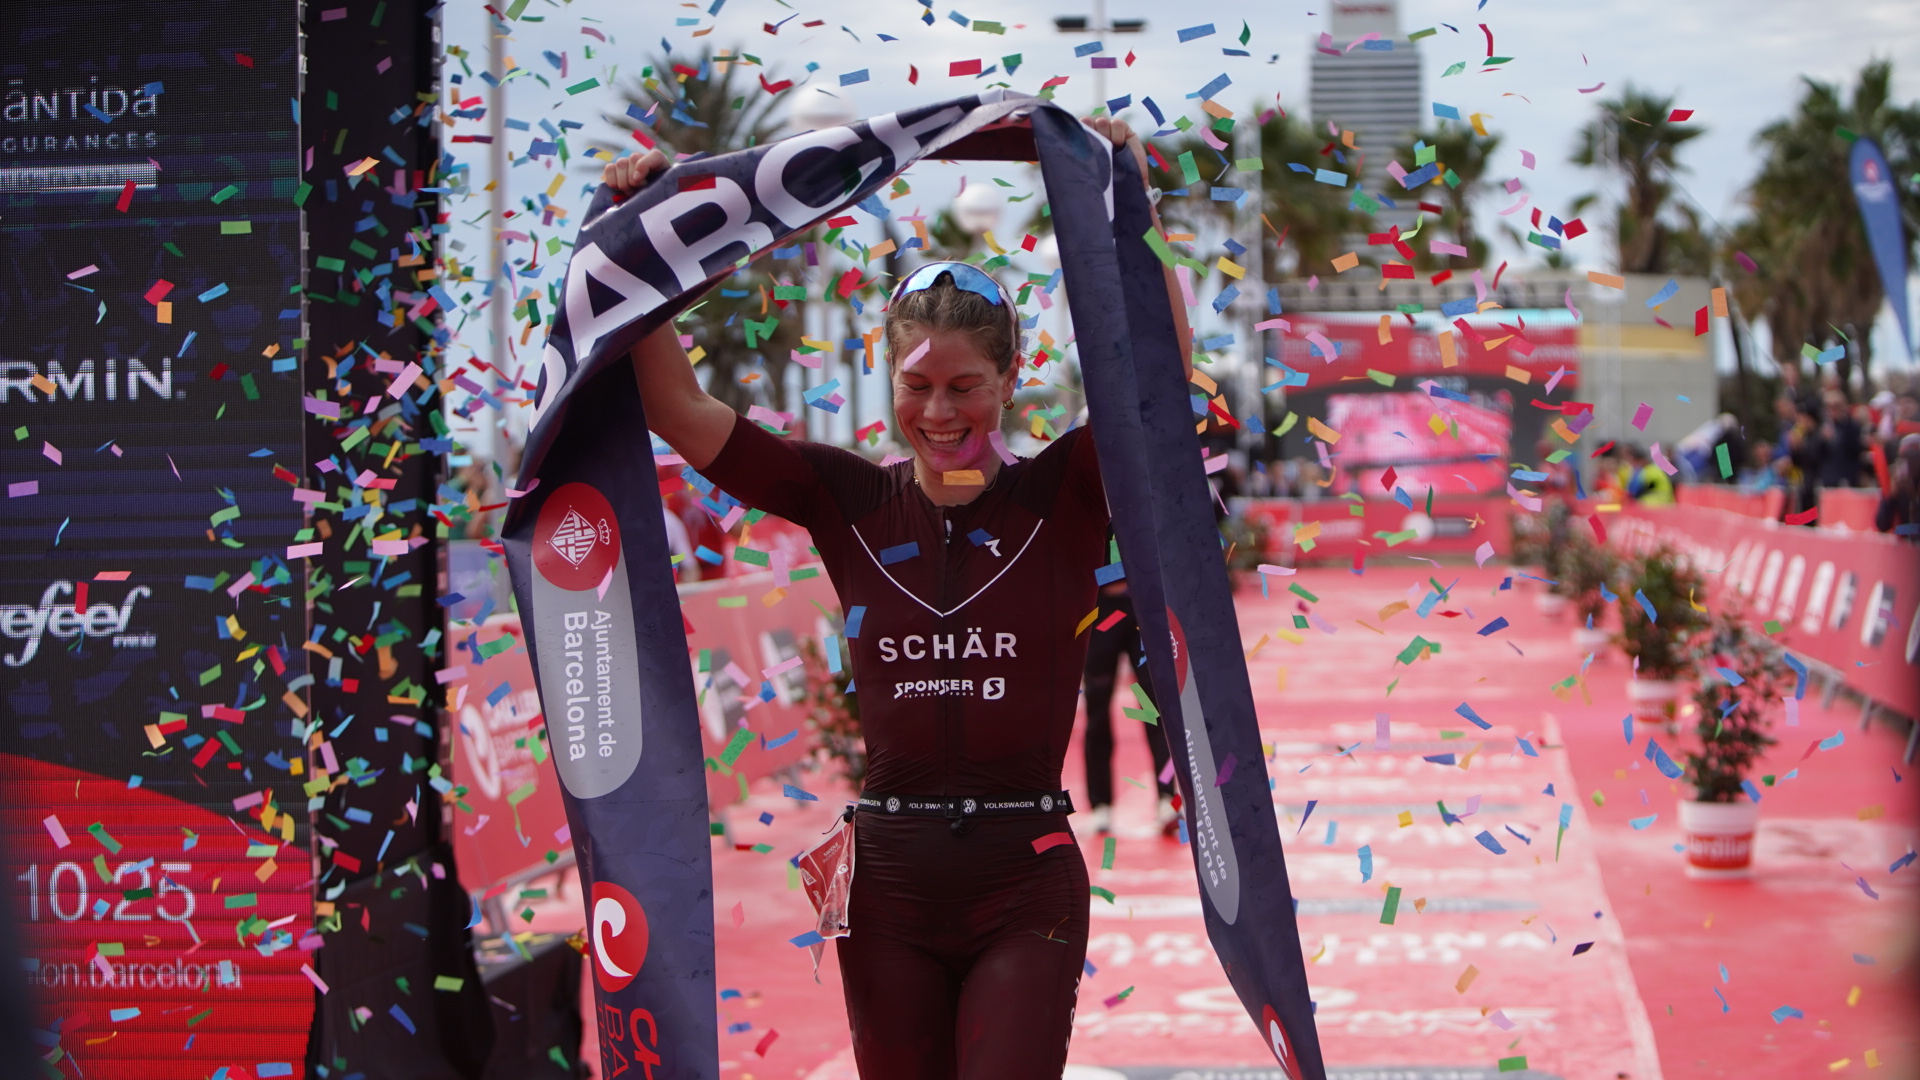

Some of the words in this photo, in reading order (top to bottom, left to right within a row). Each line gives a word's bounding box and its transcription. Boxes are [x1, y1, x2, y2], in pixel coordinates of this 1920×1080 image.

[2, 132, 158, 152] GURANCES
[878, 627, 1018, 662] SCHÄR
[590, 609, 613, 728] Ajuntament
[564, 611, 590, 761] Barcelona
[893, 679, 974, 699] SPONSER
[598, 733, 617, 758] de
[984, 801, 1035, 809] VOLKSWAGEN
